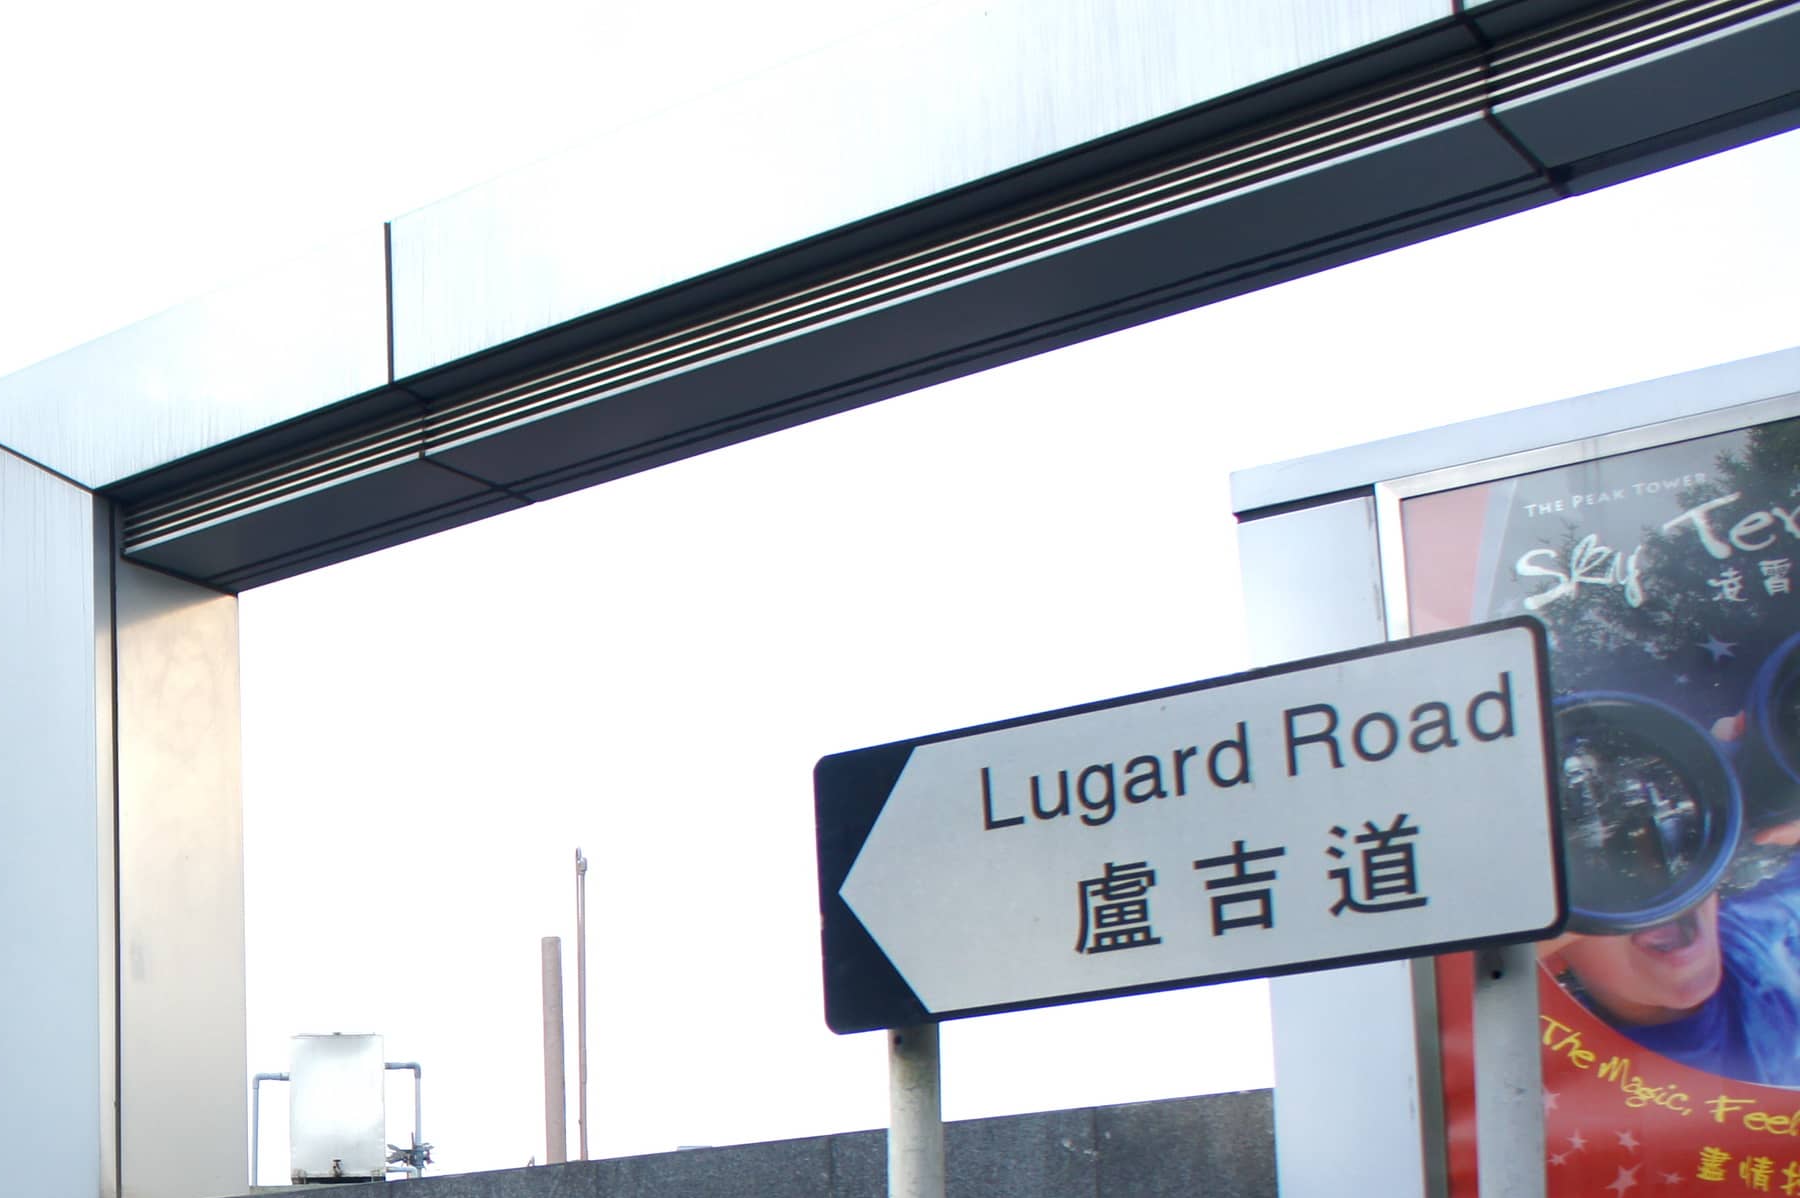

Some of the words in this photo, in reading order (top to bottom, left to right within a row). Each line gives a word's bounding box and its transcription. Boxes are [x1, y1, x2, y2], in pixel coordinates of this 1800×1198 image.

[1523, 499, 1564, 518] THE
[1572, 489, 1624, 508] PEAK
[1632, 473, 1707, 494] TOWER
[1515, 533, 1643, 609] Sky
[980, 721, 1250, 831] Lugard
[1283, 671, 1517, 777] Road
[1074, 813, 1428, 954] 盧吉道
[1540, 1015, 1596, 1069] The
[1597, 1056, 1693, 1116] Magic,
